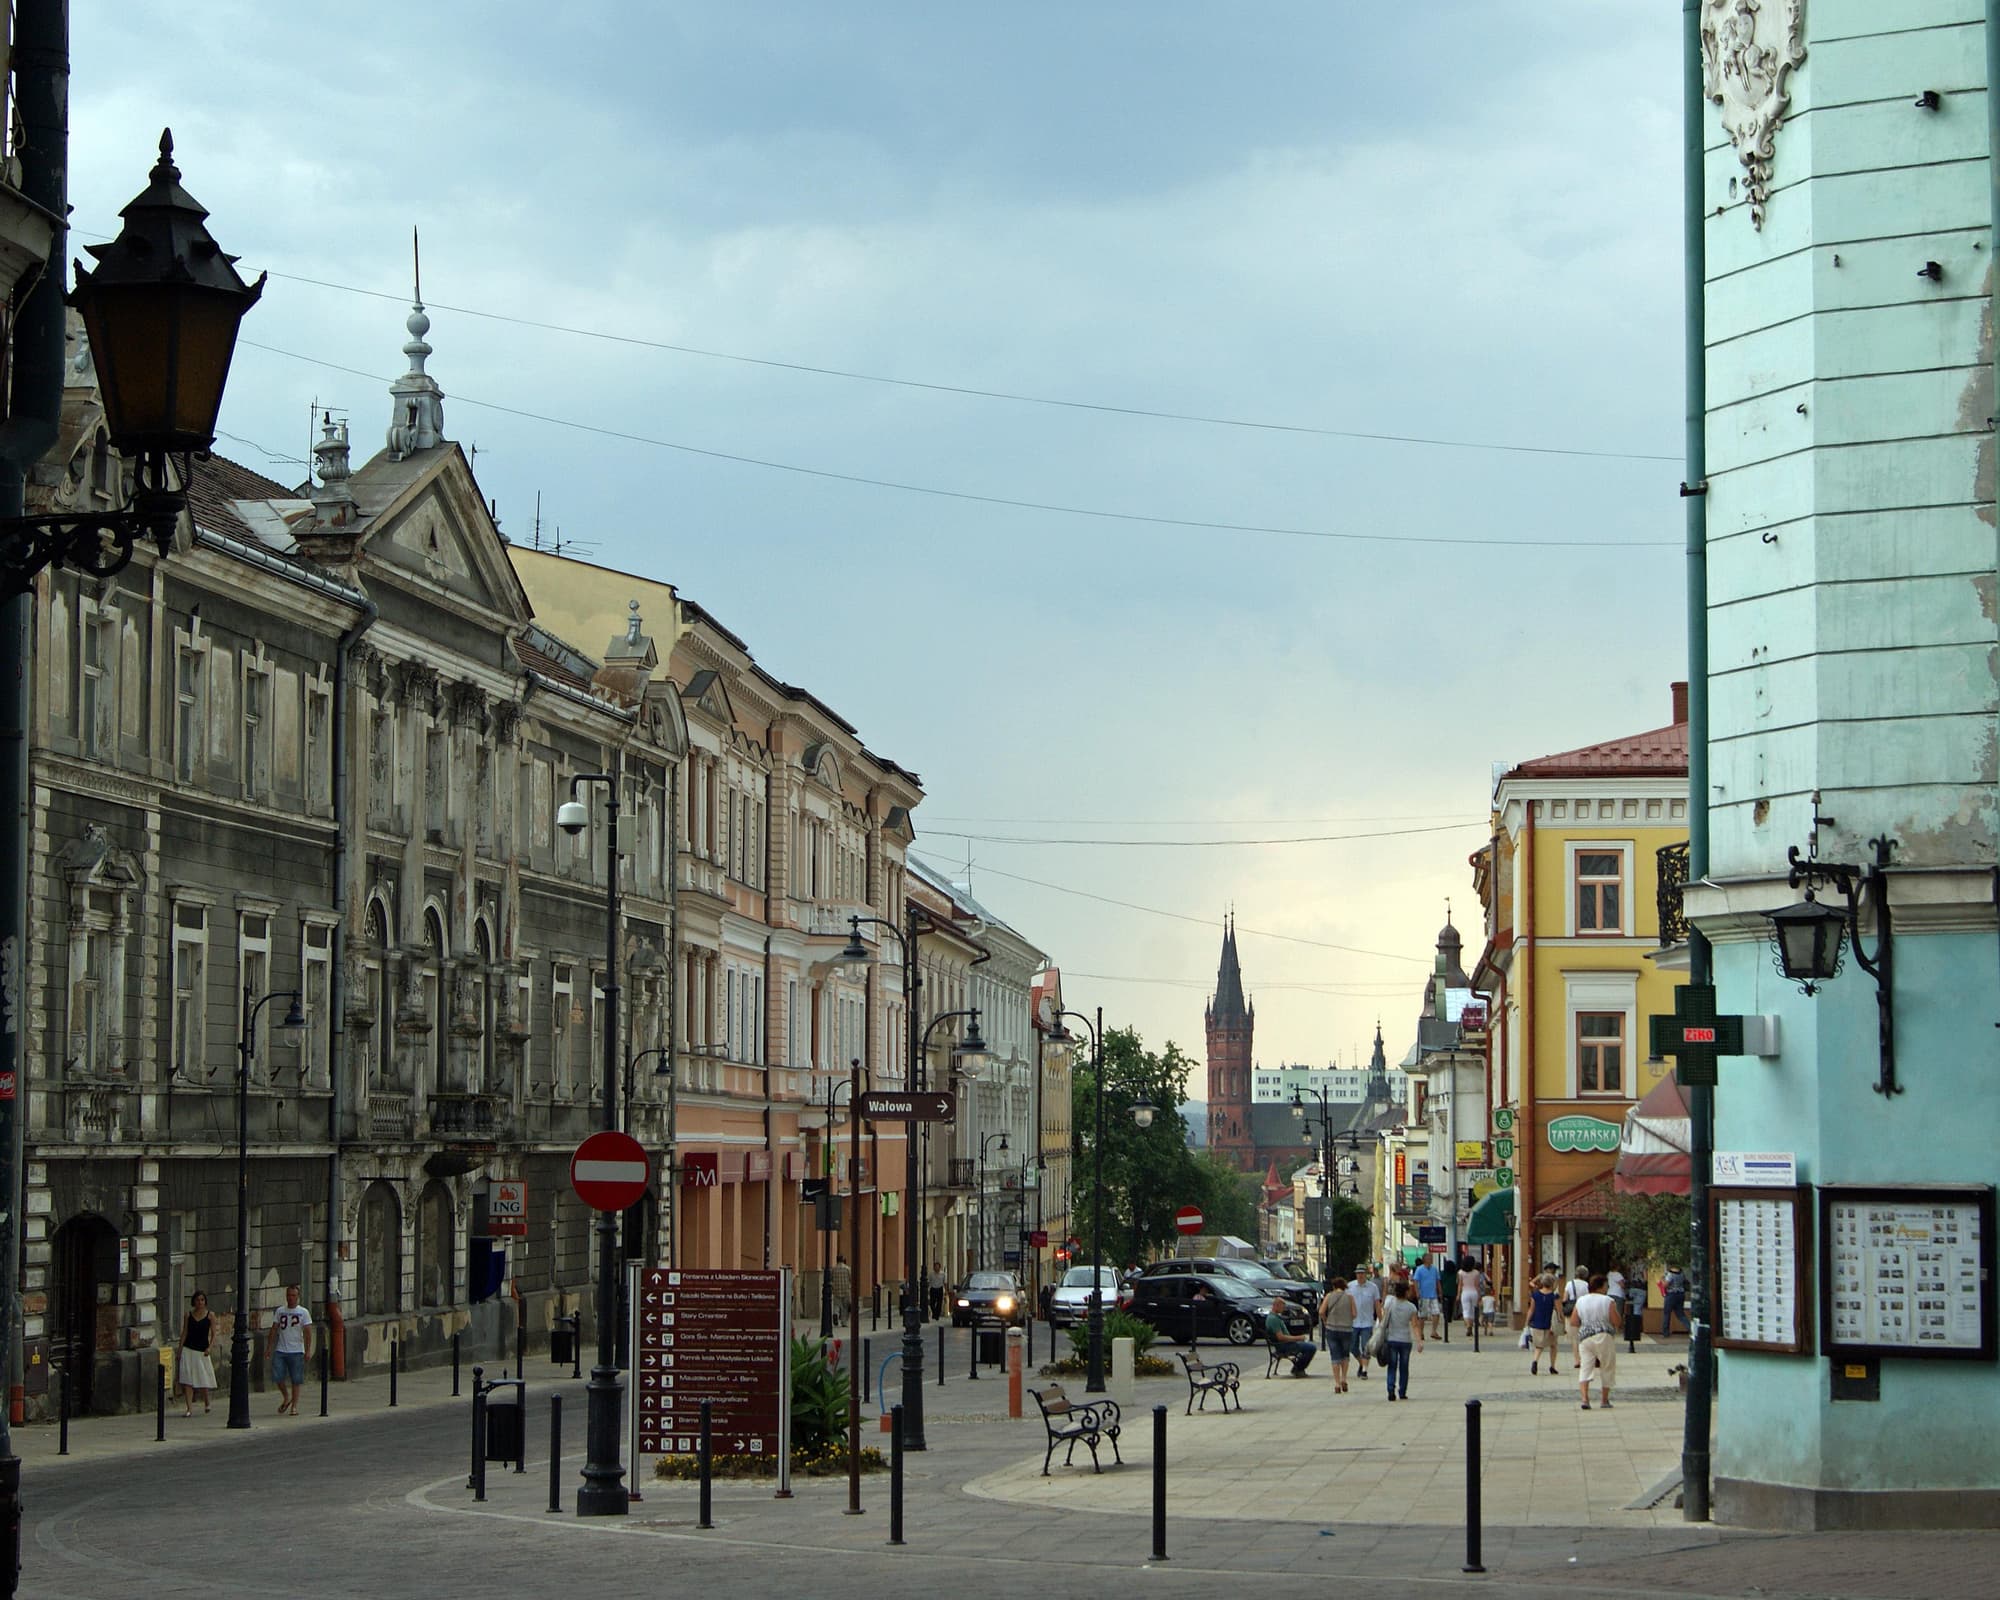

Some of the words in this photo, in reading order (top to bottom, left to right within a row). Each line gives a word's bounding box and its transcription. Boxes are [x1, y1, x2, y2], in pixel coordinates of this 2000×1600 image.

[868, 1100, 913, 1112] Wałowa
[1551, 1128, 1617, 1143] TATRZAŃSKA
[494, 1201, 520, 1212] ING
[680, 1312, 697, 1320] Stary
[280, 1315, 300, 1330] 92
